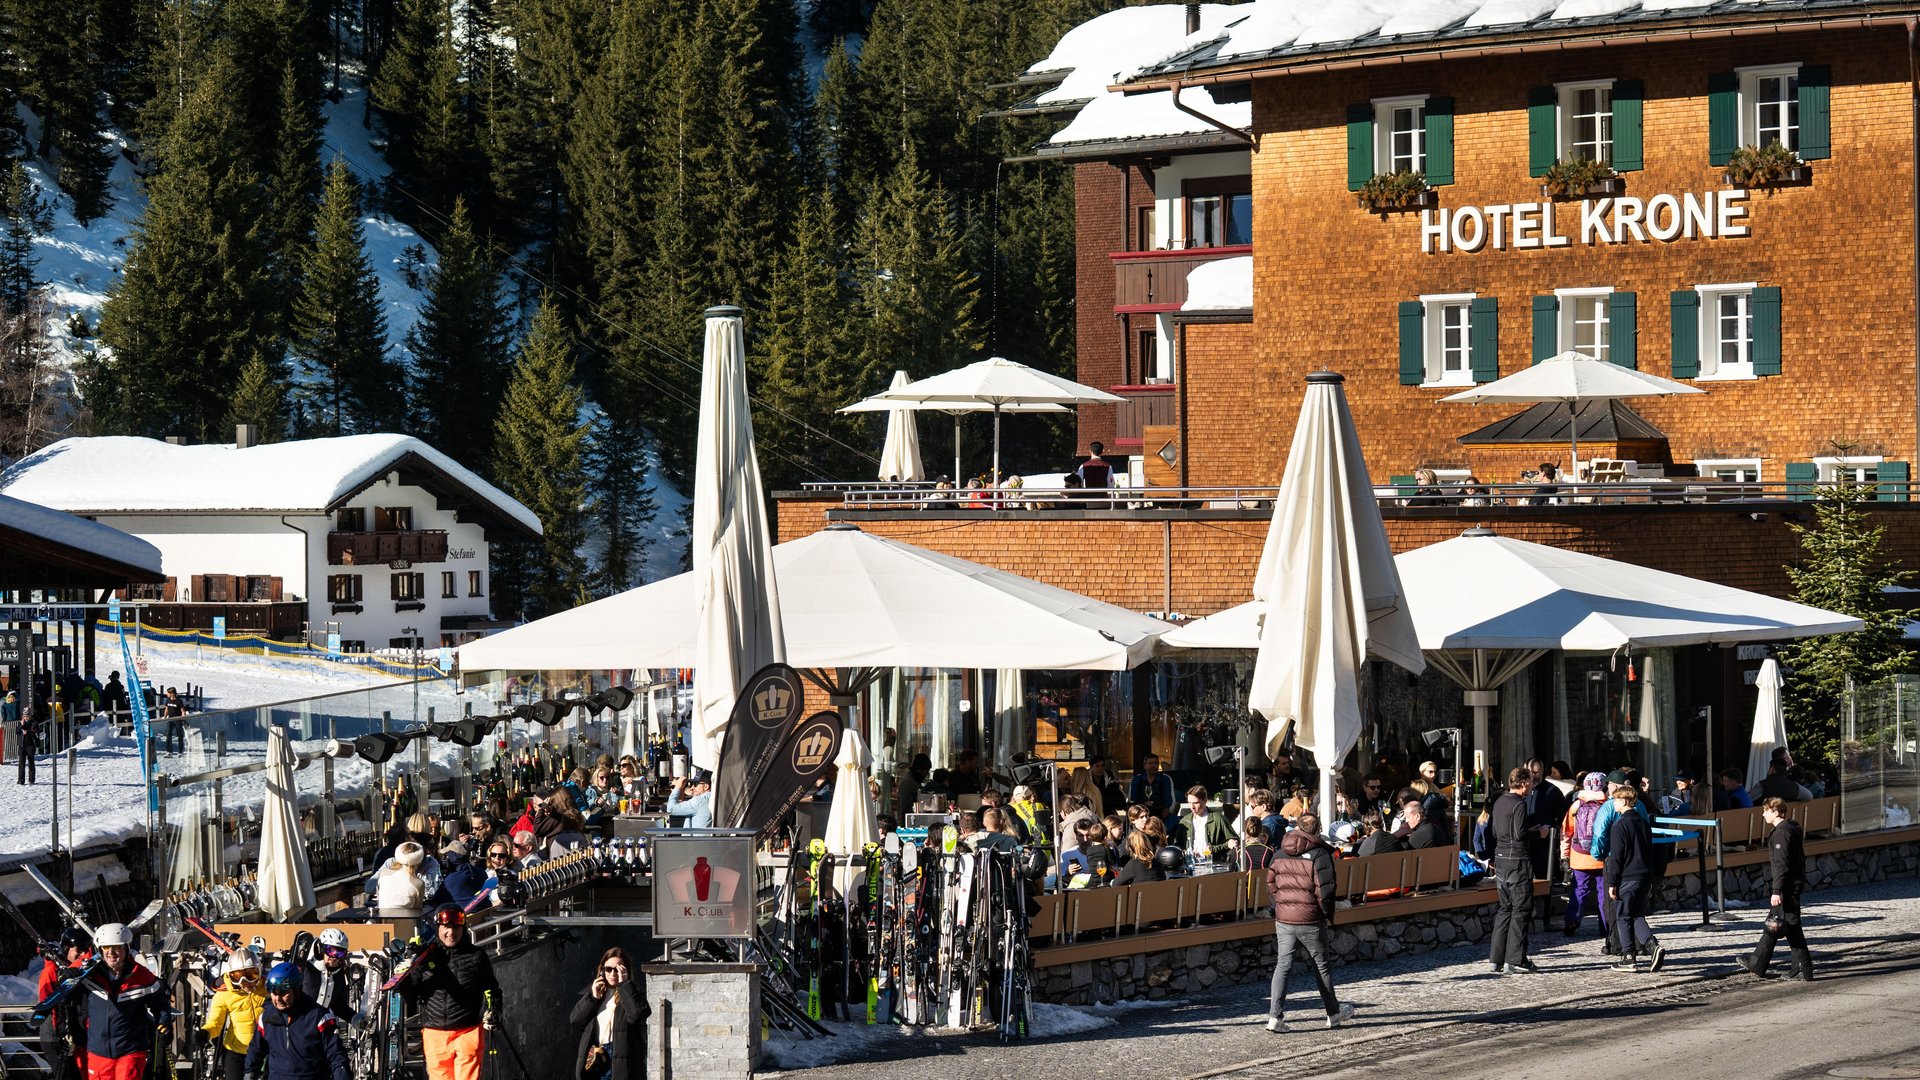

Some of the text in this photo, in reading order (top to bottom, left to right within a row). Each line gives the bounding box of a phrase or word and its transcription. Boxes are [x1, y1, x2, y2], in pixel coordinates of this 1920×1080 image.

[1421, 189, 1750, 252] HOTEL KRONE
[449, 547, 476, 559] Stefanie
[763, 818, 774, 830] BAR
[774, 803, 788, 817] CLUB
[788, 785, 803, 802] DISCO
[684, 906, 723, 917] K. CLUB
